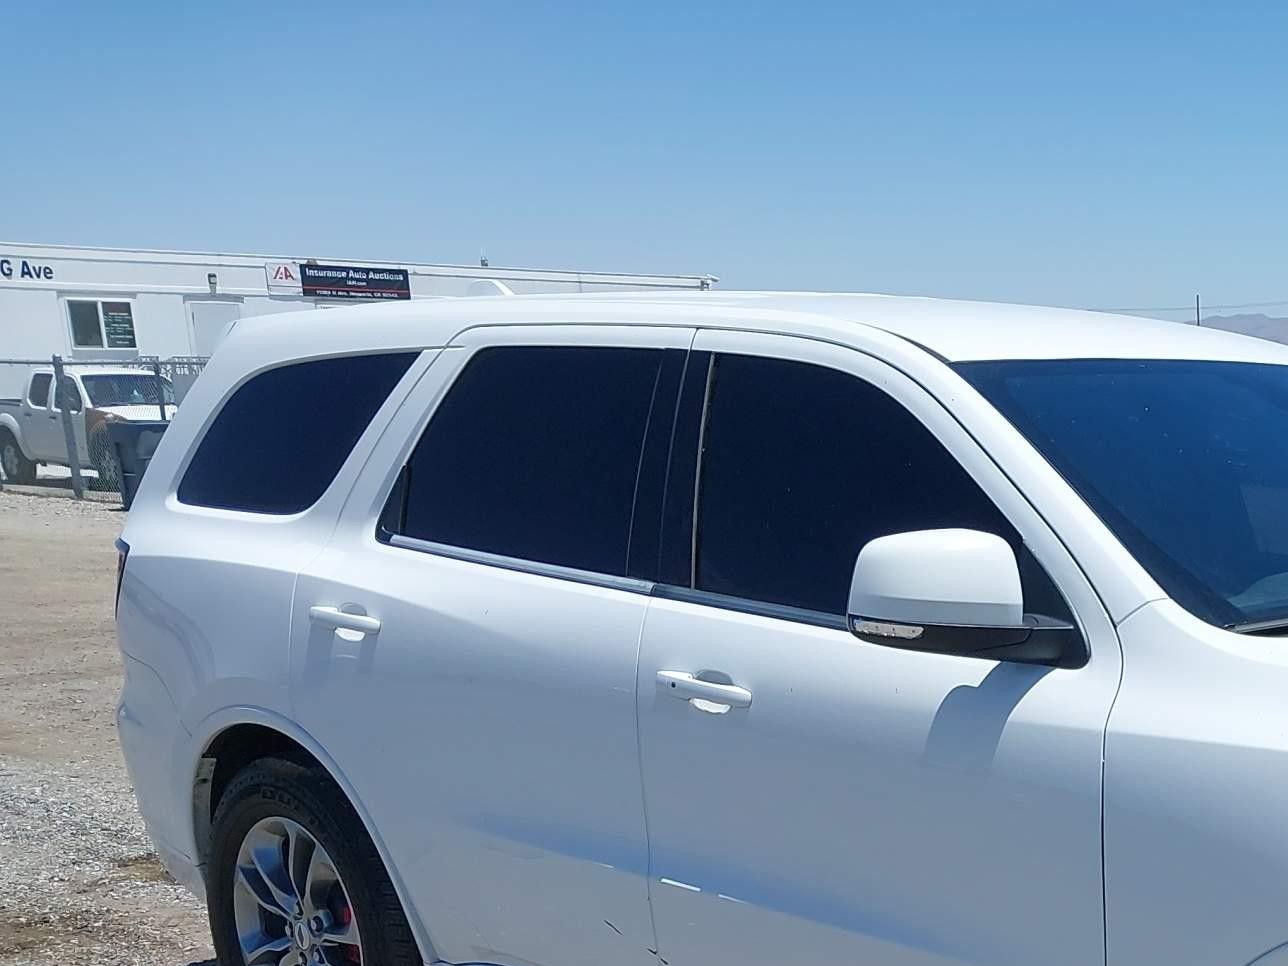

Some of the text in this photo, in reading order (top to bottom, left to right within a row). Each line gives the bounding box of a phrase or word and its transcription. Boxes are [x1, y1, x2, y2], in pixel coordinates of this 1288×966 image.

[0, 259, 54, 280] G Ave
[305, 267, 404, 281] Insurance Auto Auctions
